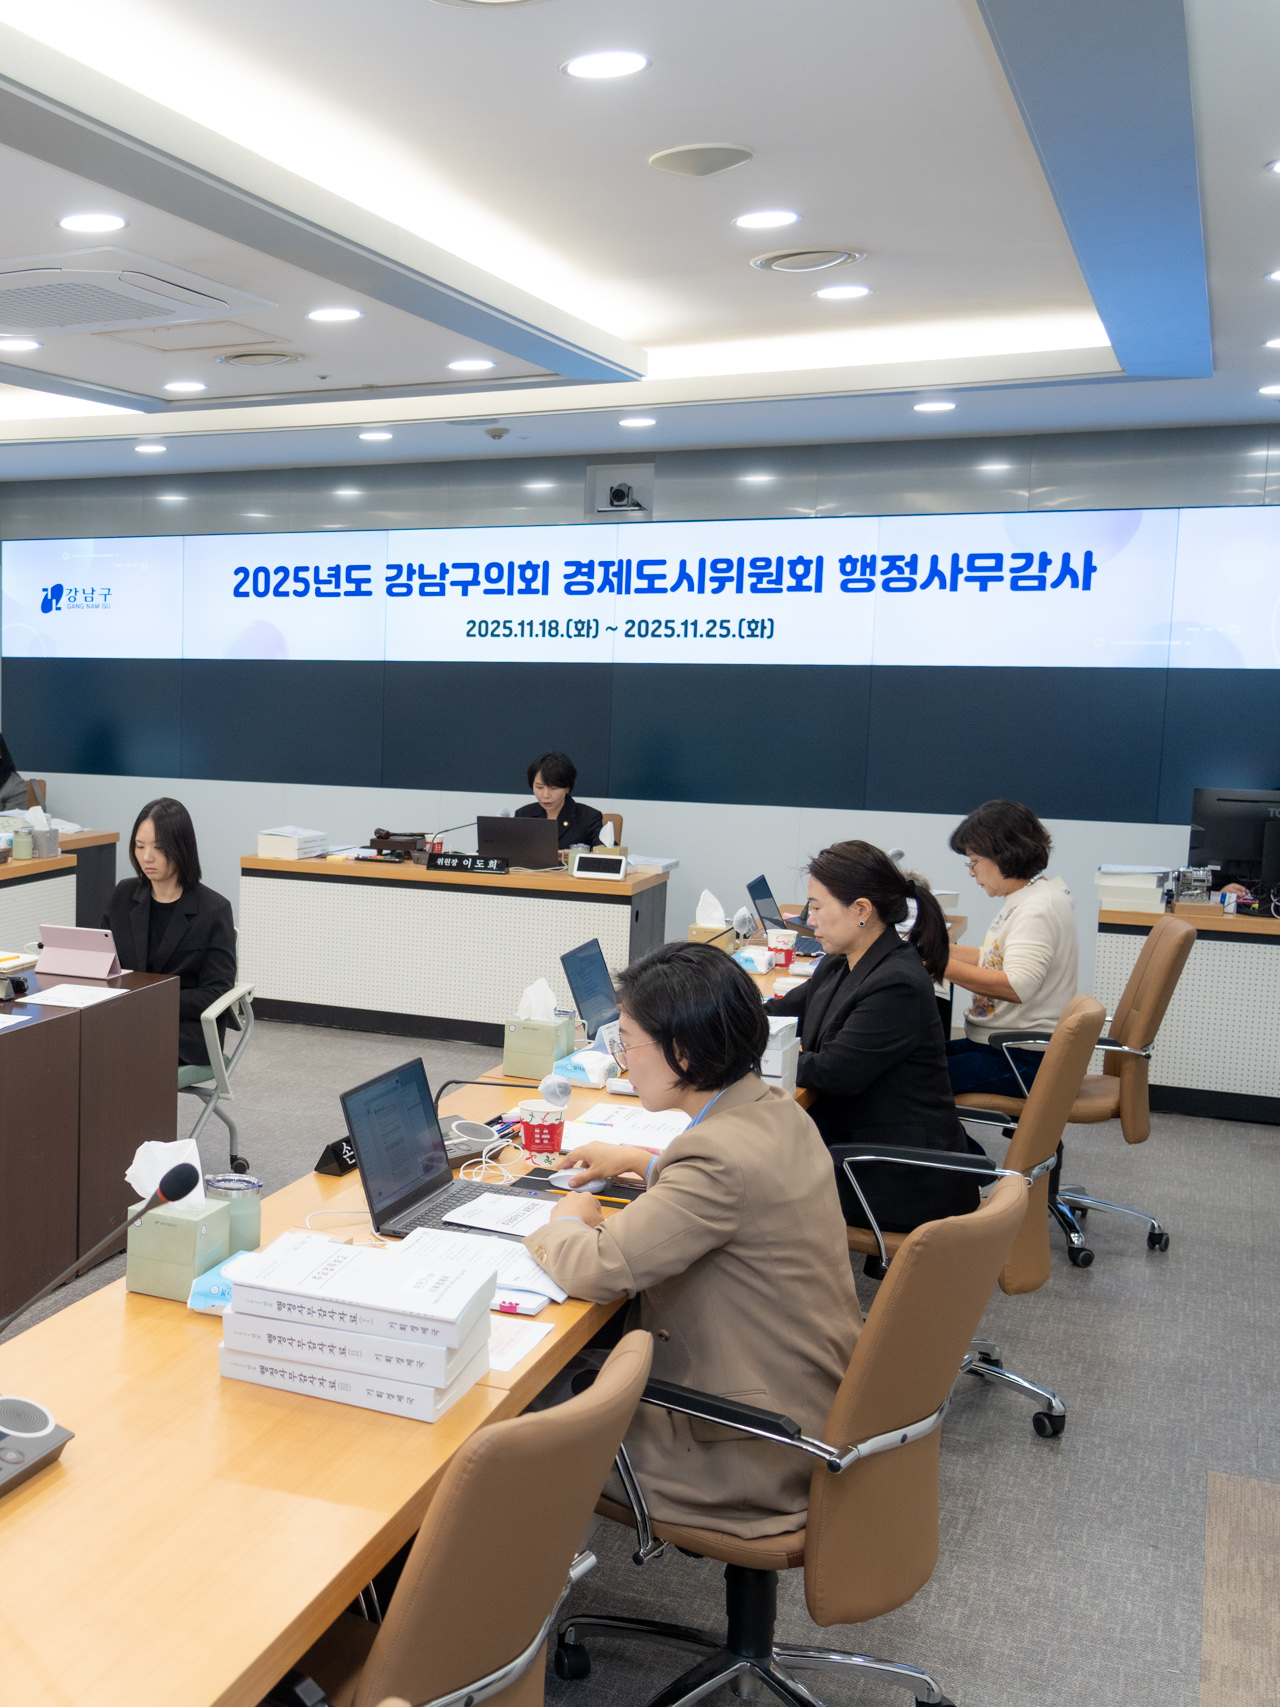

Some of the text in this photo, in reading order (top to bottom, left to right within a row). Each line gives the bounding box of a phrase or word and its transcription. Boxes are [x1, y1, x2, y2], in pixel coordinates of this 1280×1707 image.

[233, 550, 1098, 598] 2025년도 강남구의회 경제도시위원회 행정사무감사
[65, 587, 113, 603] 강남구
[466, 618, 600, 640] 2025.11.18.(화)
[624, 618, 775, 640] 2025.11.25.(화)
[436, 857, 498, 870] 위원장 이도희
[388, 1321, 441, 1337] 기획경제국
[374, 1353, 426, 1369] 기획경제국
[365, 1388, 416, 1405] 기획경제국
